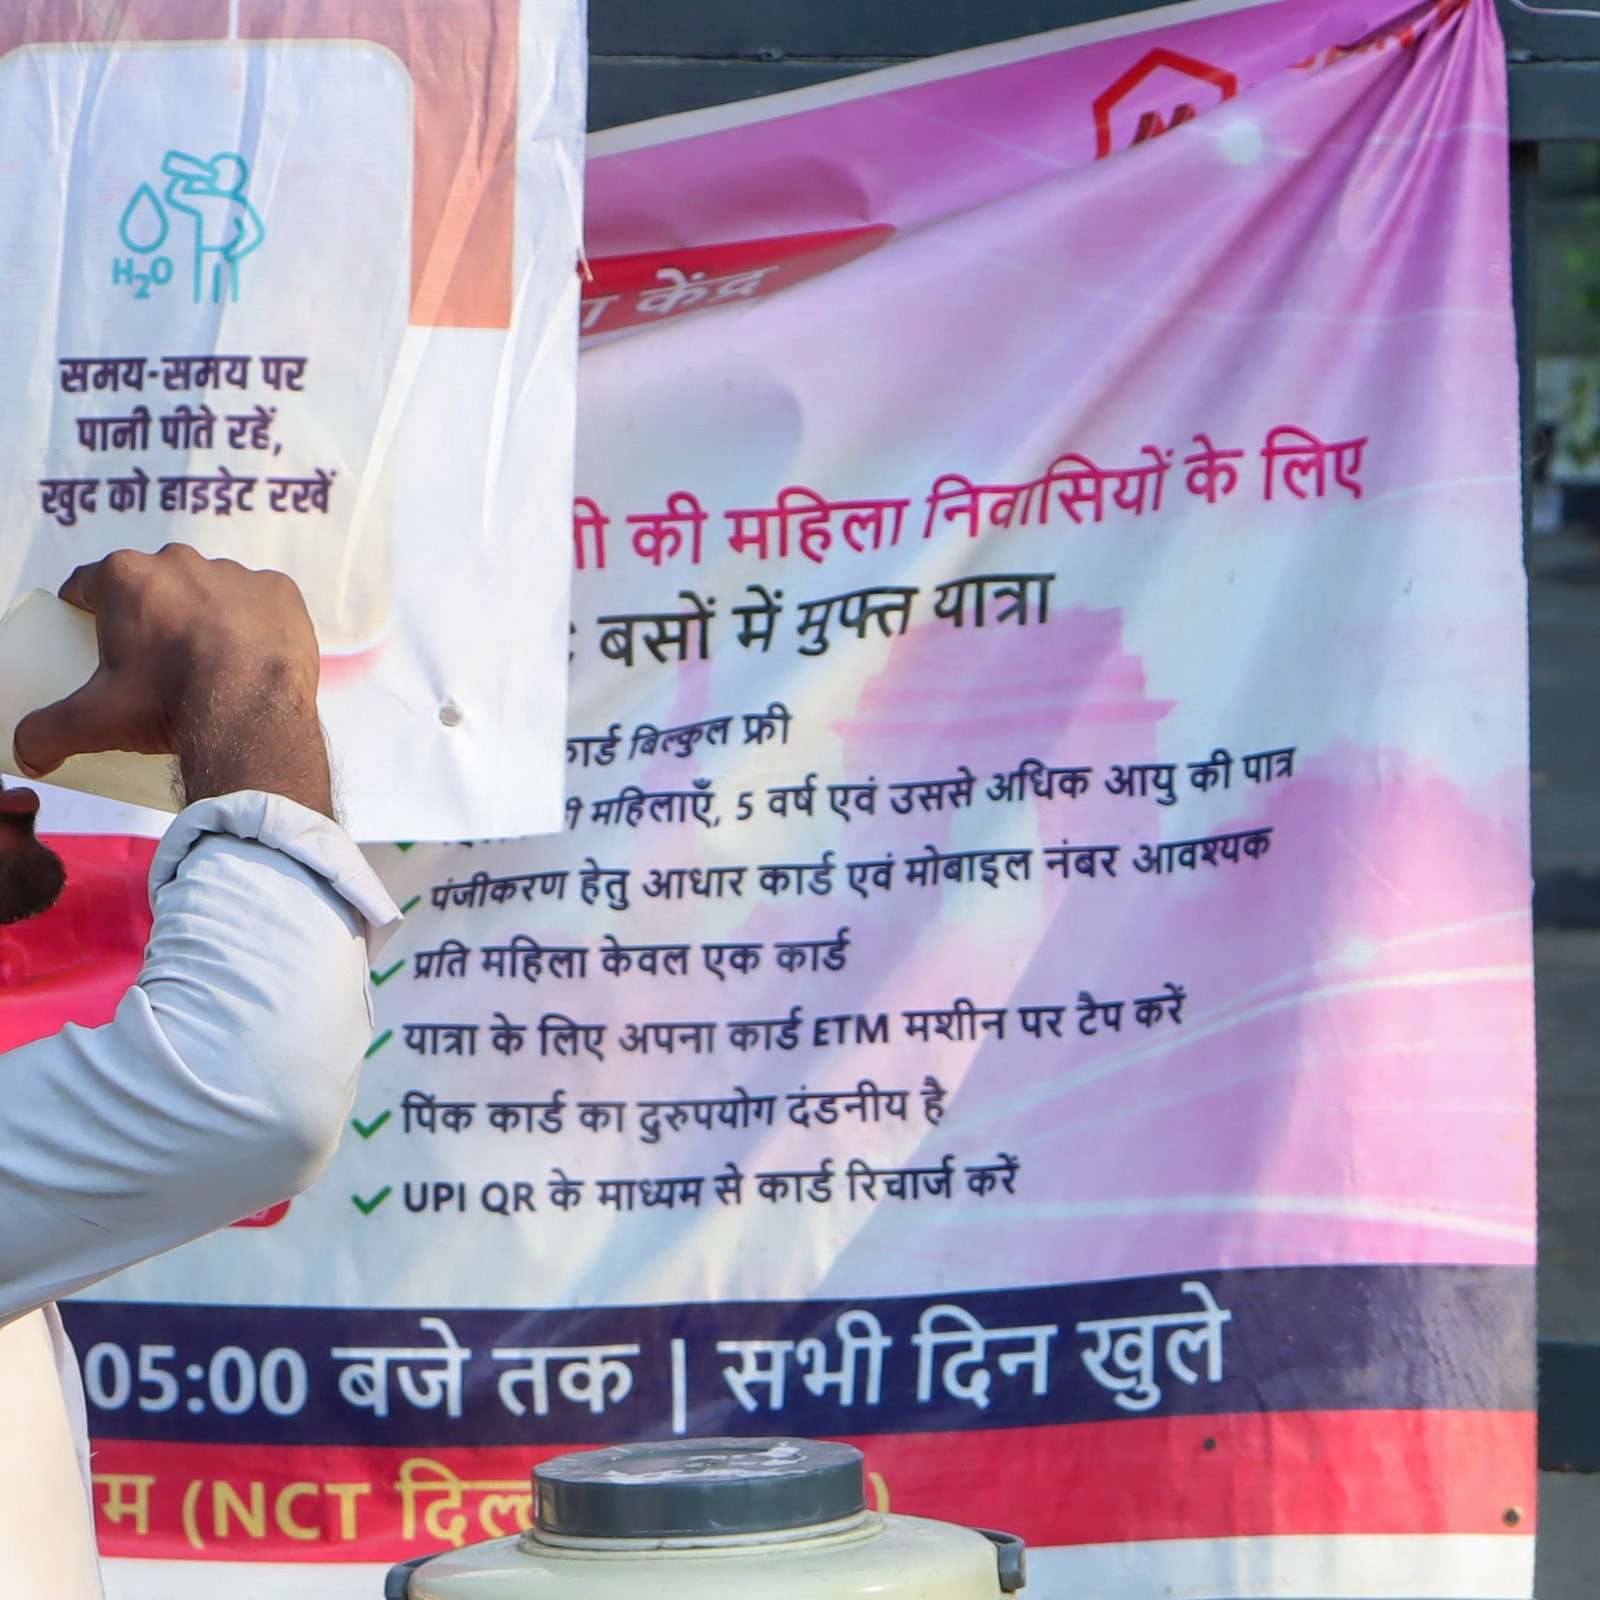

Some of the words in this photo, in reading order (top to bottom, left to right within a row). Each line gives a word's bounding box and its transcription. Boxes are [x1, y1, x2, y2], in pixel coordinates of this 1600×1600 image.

[59, 355, 250, 393] समय-समय
[260, 357, 307, 391] पर
[76, 405, 152, 451] पानी
[159, 404, 216, 449] पीते
[225, 405, 281, 455] रहें,
[40, 479, 100, 526] खुद
[107, 467, 150, 512] को
[157, 466, 257, 515] हाइड्रेट
[267, 469, 336, 513] रखें
[626, 491, 708, 566] की
[724, 487, 910, 563] महिला
[924, 445, 1174, 538] निवासियों
[1184, 432, 1243, 503] के
[1260, 425, 1368, 500] लिए
[597, 591, 715, 667] बसों
[732, 585, 782, 652] में
[797, 587, 919, 656] मुफ्त
[935, 574, 1055, 627] यात्रा
[629, 716, 733, 760] बिल्कुल
[742, 702, 792, 744] फ्री
[591, 779, 719, 828] महिलाएँ,
[737, 792, 753, 820] 5
[768, 773, 816, 817] वर्ष
[827, 776, 878, 822] एवं
[889, 766, 977, 814] उससे
[987, 758, 1092, 801] अधिक
[1105, 765, 1177, 806] आयु
[1188, 749, 1233, 792] की
[1242, 748, 1296, 783] पात्र
[431, 871, 569, 911] पंजीकरण
[579, 860, 630, 910] हेतु
[643, 867, 747, 899] आधार
[758, 851, 835, 896] कार्ड
[847, 860, 895, 898] एवं
[904, 844, 1032, 888] मोबाइल
[1044, 840, 1120, 878] नंबर
[1133, 827, 1274, 874] आवश्यक
[414, 940, 471, 979] प्रति
[480, 935, 589, 983] महिला
[600, 935, 690, 976] केवल
[702, 944, 763, 981] एक
[774, 927, 850, 972] कार्ड
[403, 1024, 479, 1056] यात्रा
[489, 1012, 527, 1056] के
[537, 1013, 606, 1061] लिए
[619, 1023, 717, 1054] अपना
[728, 1006, 803, 1051] कार्ड
[813, 1014, 888, 1047] ETM
[902, 998, 1008, 1041] मशीन
[1018, 1006, 1066, 1038] पर
[1076, 992, 1125, 1035] टैप
[1133, 983, 1186, 1028] करें
[400, 1090, 476, 1133] पिंक
[486, 1089, 566, 1133] कार्ड
[577, 1102, 626, 1132] का
[637, 1086, 778, 1143] दुरुपयोग
[785, 1080, 909, 1128] दंडनीय
[920, 1076, 946, 1126] है
[404, 1182, 465, 1212] UPI
[481, 1182, 535, 1216] QR
[548, 1169, 584, 1211] के
[596, 1176, 705, 1210] माध्यम
[713, 1162, 744, 1205] से
[755, 1158, 834, 1203] कार्ड
[846, 1154, 955, 1201] रिचार्ज
[965, 1153, 1020, 1196] करें
[85, 1343, 307, 1415] 05:00
[331, 1318, 472, 1416] बजे
[491, 1344, 640, 1415] तक
[716, 1310, 890, 1411] सभी
[912, 1305, 1058, 1408] दिन
[1077, 1282, 1232, 1410] खुले
[184, 1481, 371, 1550] (NCT
